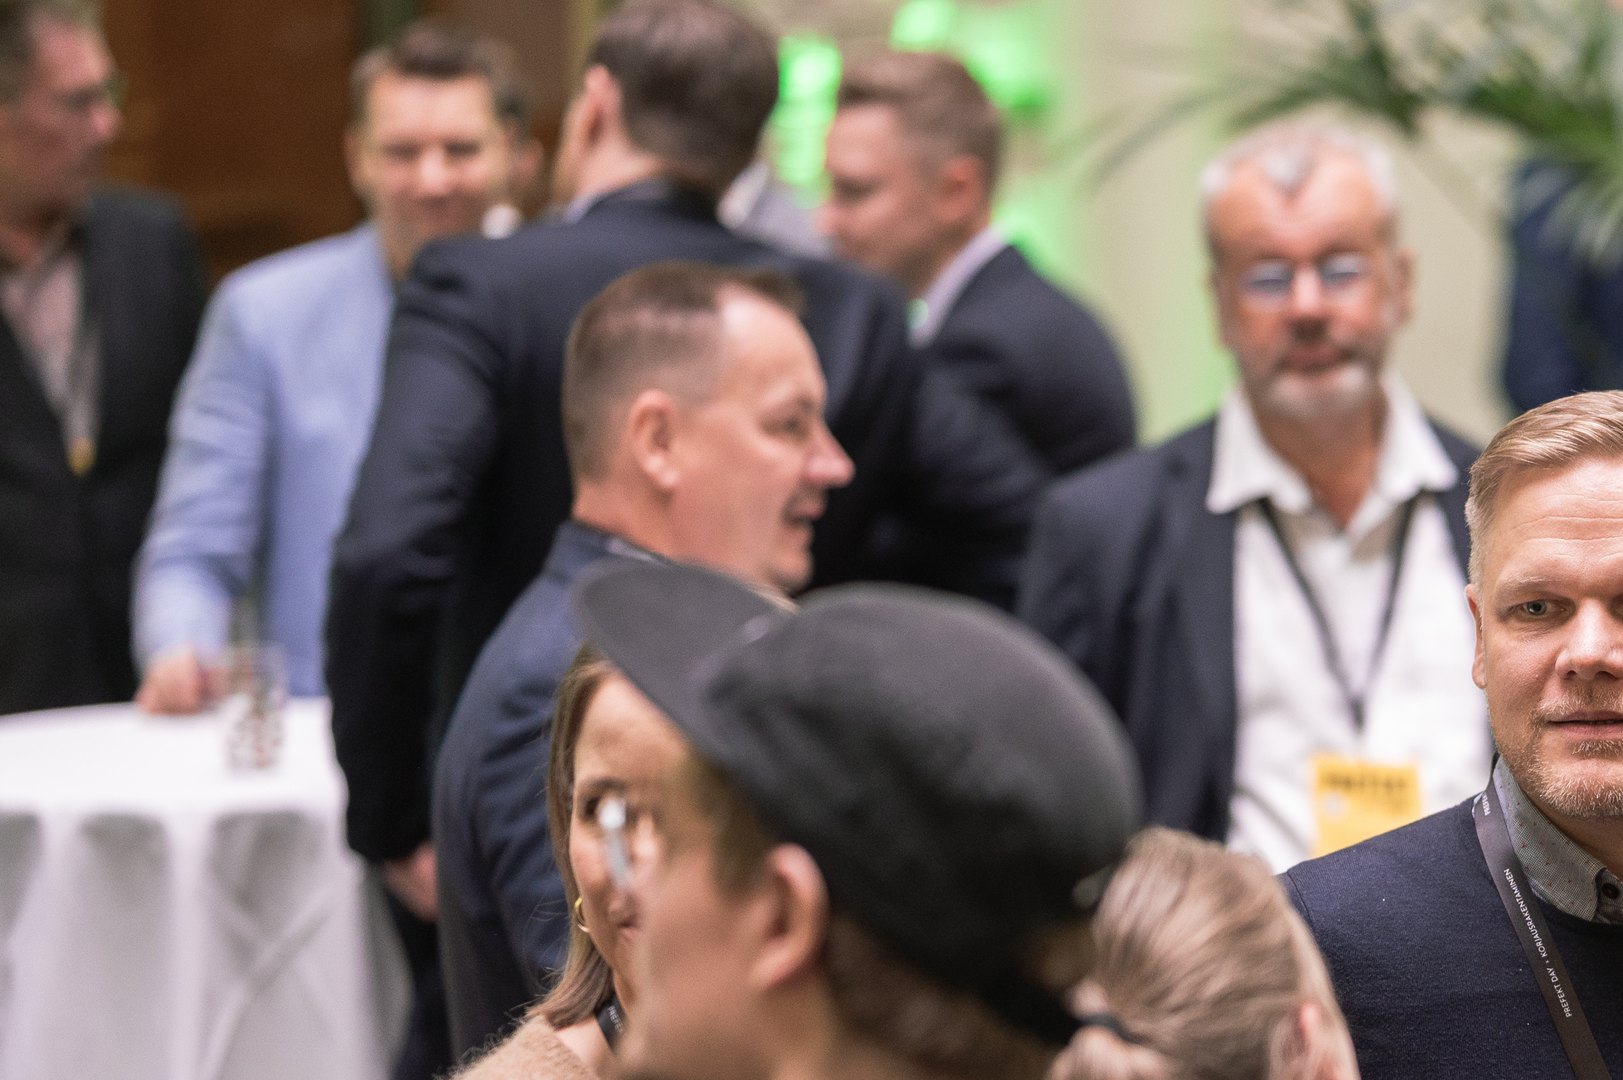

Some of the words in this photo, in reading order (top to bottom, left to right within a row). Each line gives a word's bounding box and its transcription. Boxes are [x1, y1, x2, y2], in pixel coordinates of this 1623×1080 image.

[1503, 868, 1548, 958] KORJAUSRAKENTAMINEN
[1546, 967, 1559, 983] DAY
[1553, 984, 1572, 1018] PREFEKT
